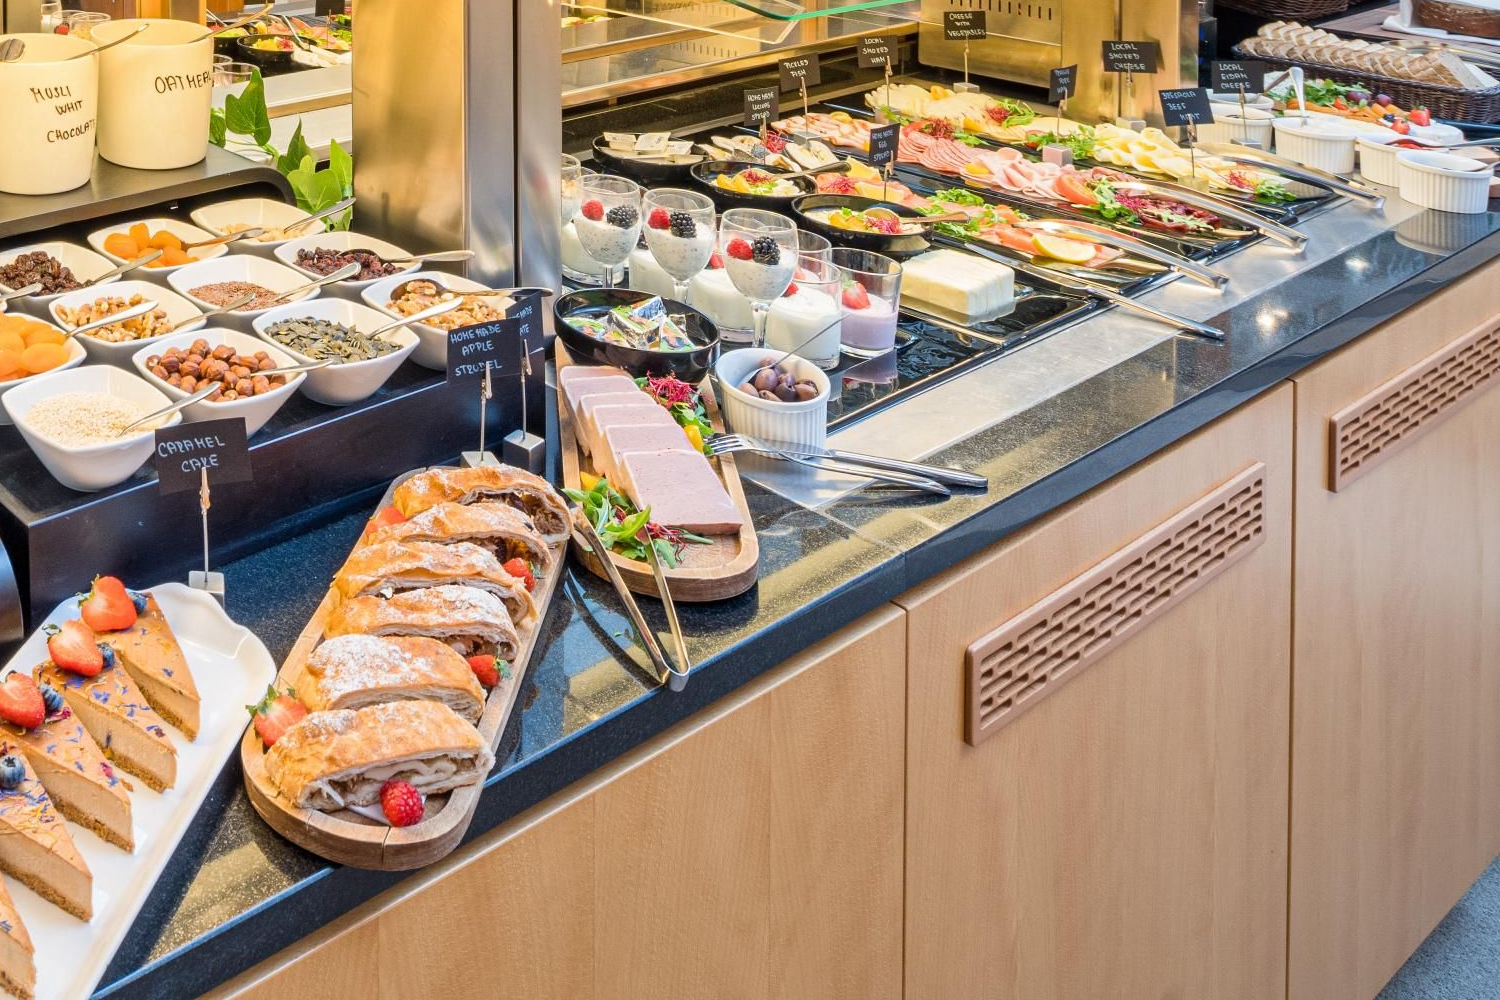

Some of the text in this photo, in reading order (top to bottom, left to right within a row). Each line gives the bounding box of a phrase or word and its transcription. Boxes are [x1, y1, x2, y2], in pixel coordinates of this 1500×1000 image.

[864, 37, 884, 45] LOCAL
[1110, 42, 1138, 51] LOCAL
[1218, 63, 1244, 71] LOCAL
[29, 85, 72, 103] MUSLI
[55, 100, 84, 116] WHIT
[461, 340, 495, 357] APPLE
[181, 454, 219, 472] CAKE
